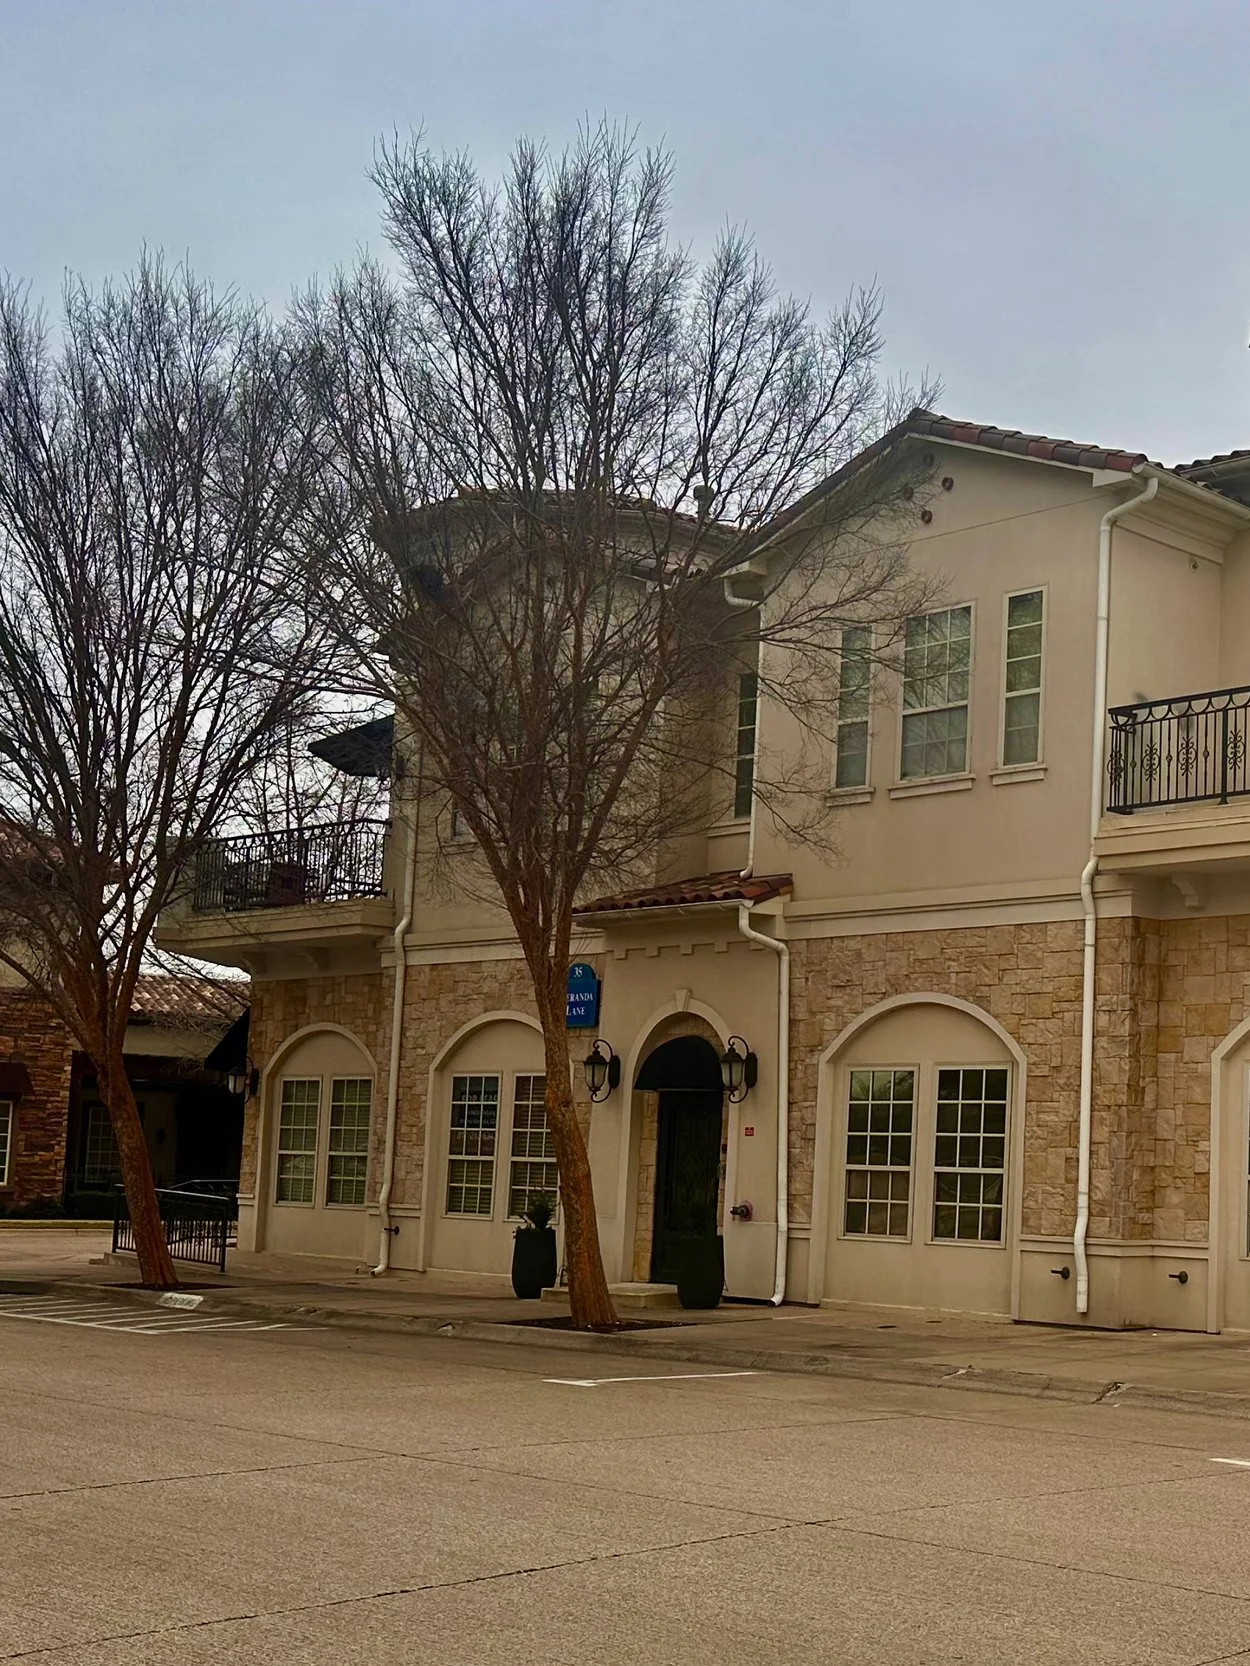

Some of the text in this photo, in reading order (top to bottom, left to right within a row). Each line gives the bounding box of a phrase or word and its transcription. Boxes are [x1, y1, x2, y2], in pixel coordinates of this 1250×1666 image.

[573, 966, 583, 978] 35
[566, 992, 593, 1002] ERANDA
[566, 1004, 586, 1016] LANE
